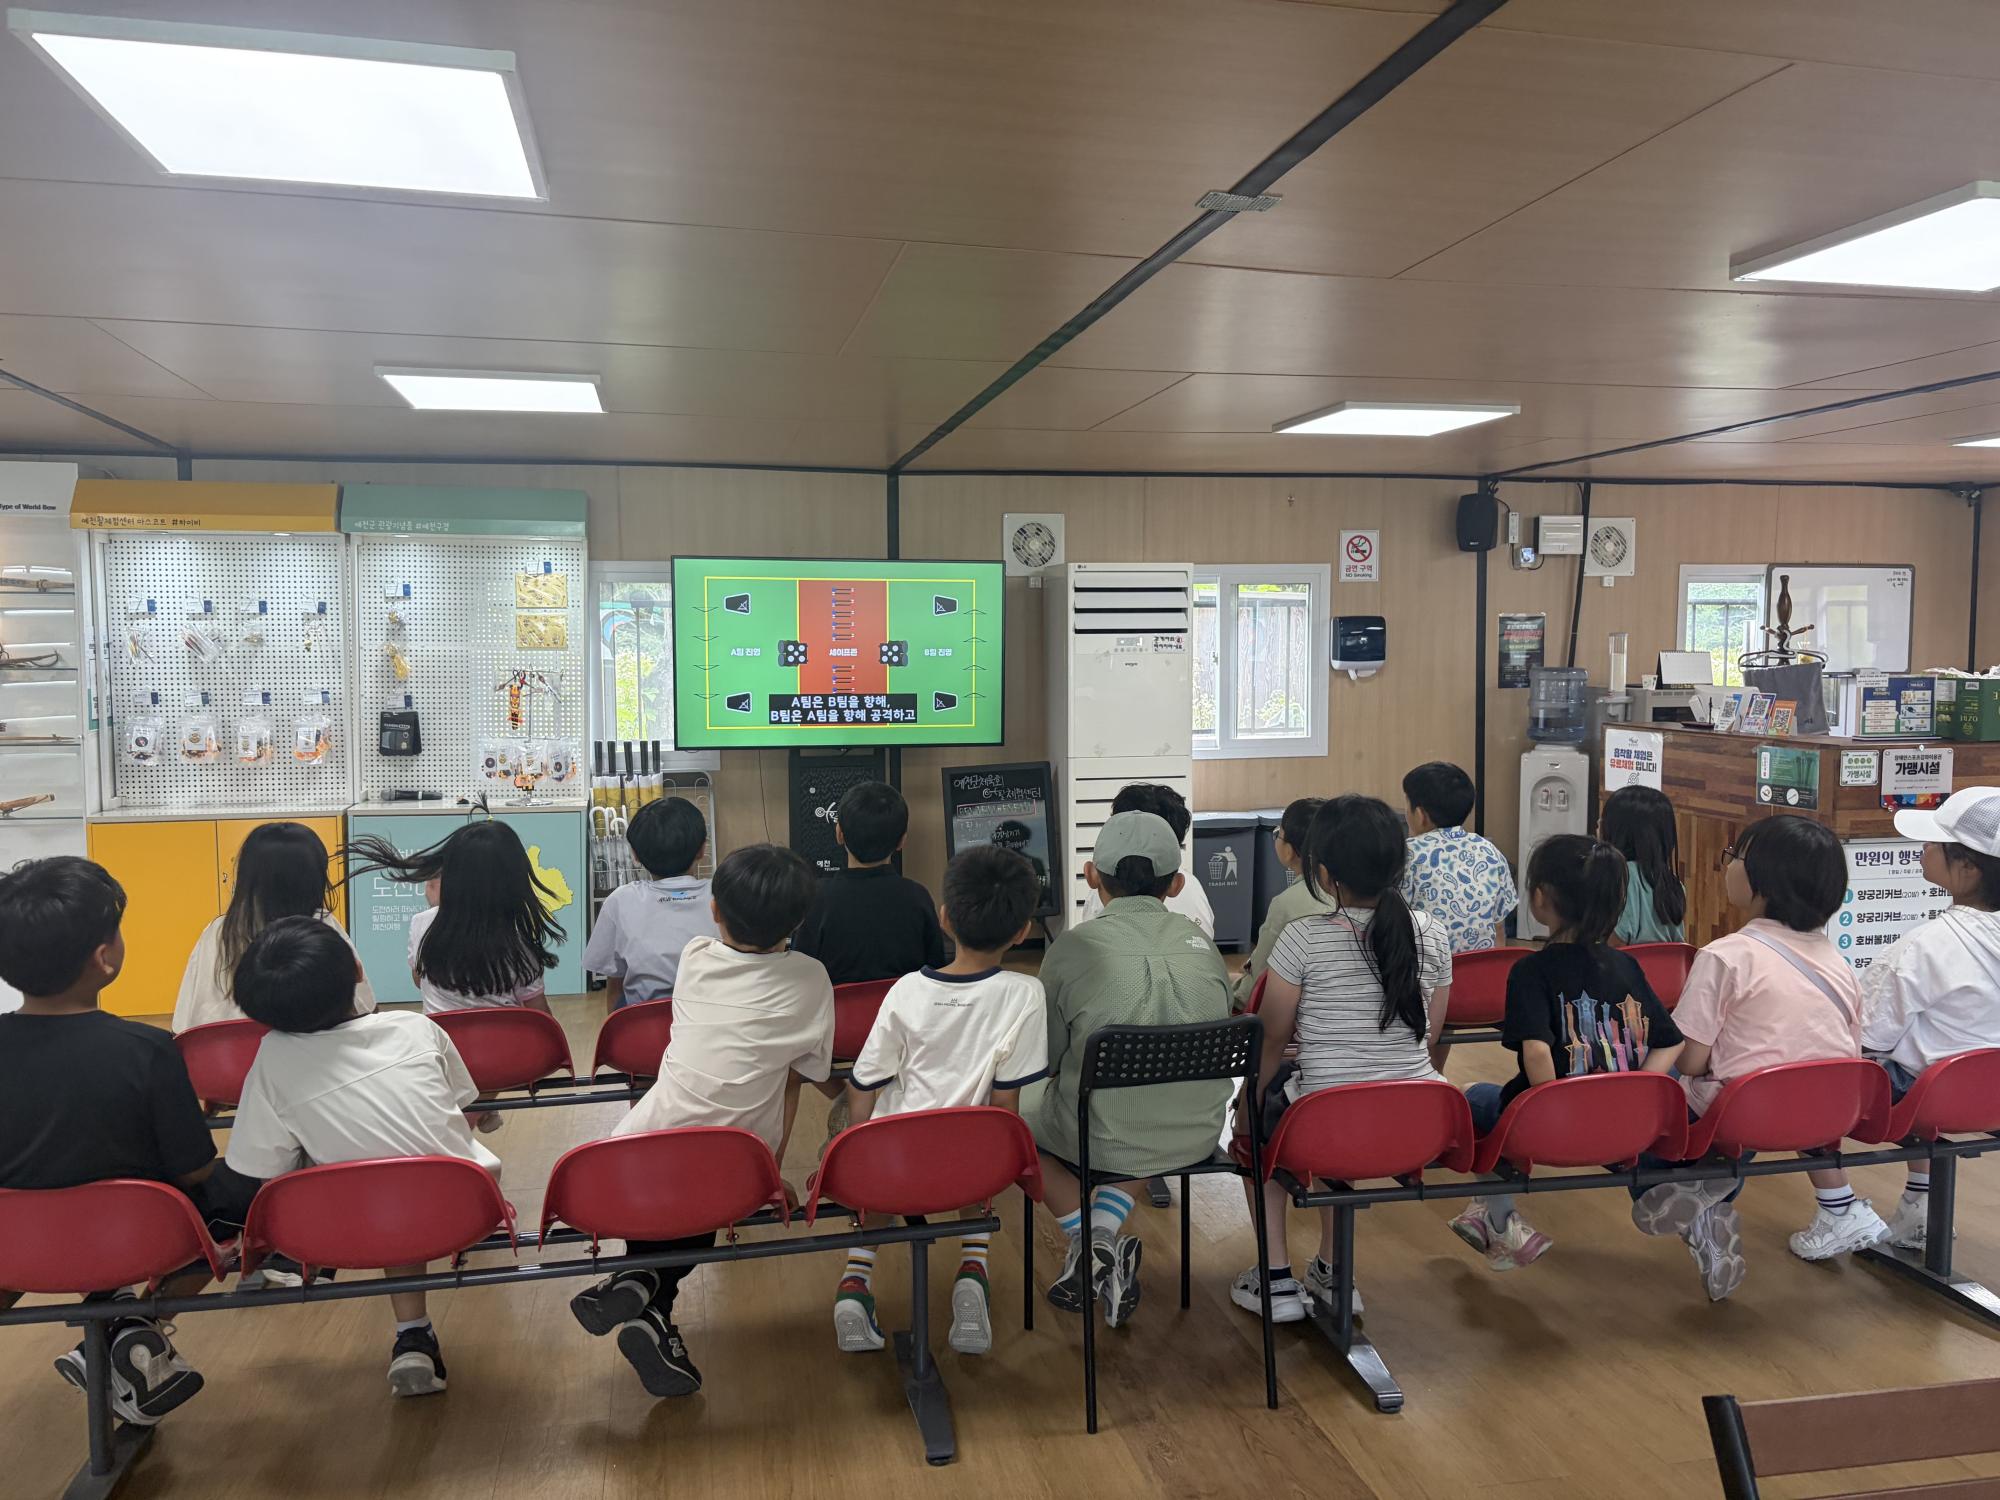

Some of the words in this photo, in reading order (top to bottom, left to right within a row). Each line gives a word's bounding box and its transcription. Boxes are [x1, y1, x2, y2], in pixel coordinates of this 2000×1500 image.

[137, 518, 167, 526] 마스코트
[1345, 565, 1358, 573] 금연
[1360, 565, 1373, 573] 구역
[745, 648, 760, 656] 진영
[829, 648, 858, 657] 세이프존
[938, 648, 953, 657] 진영
[791, 696, 824, 708] A팀은
[828, 696, 860, 708] B팀을
[864, 695, 890, 708] 향해,
[770, 710, 803, 722] B팀은
[807, 710, 839, 722] A팀을
[844, 709, 866, 722] 향해
[870, 709, 916, 722] 공격하고
[1634, 749, 1653, 761] 체험은
[1610, 758, 1634, 770] 유료체험
[1635, 761, 1657, 772] 입니다!
[1895, 761, 1941, 775] 가맹시설
[1847, 770, 1872, 778] 가맹시설
[1855, 851, 1894, 867] 만원의
